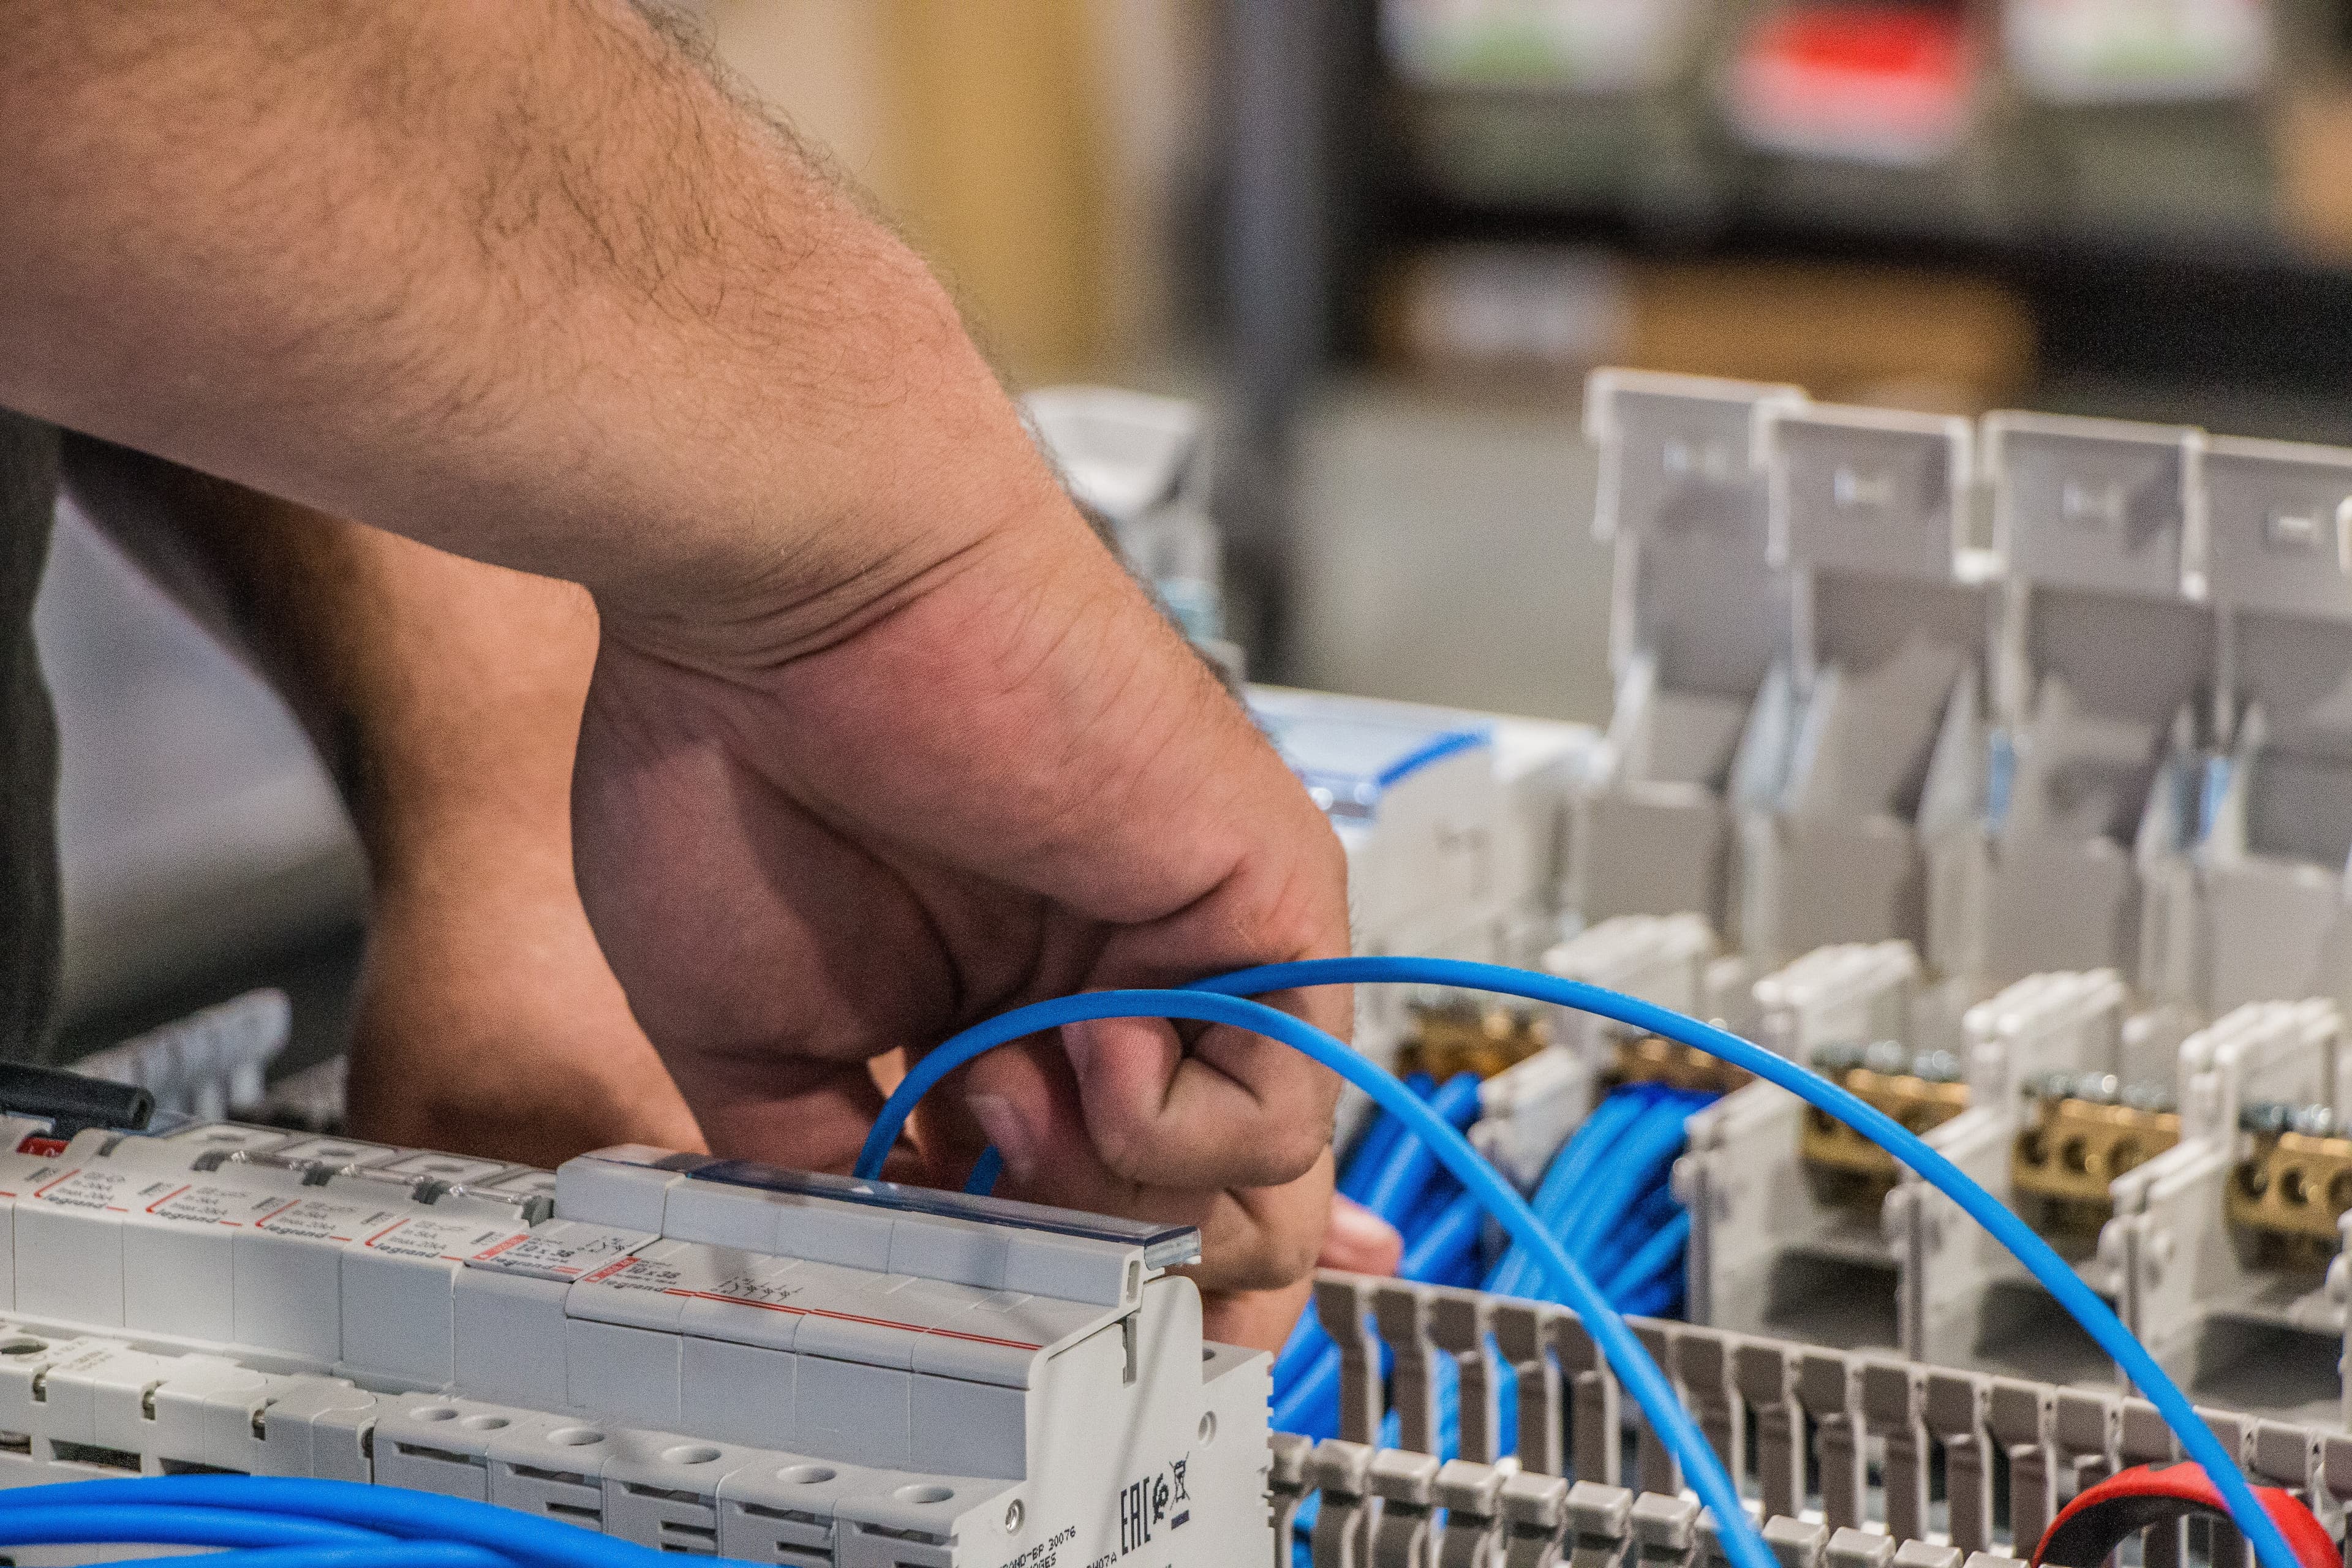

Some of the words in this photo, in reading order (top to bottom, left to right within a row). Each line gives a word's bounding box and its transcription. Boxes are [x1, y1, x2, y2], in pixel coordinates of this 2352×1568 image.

[43, 1194, 107, 1209] legrand
[156, 1208, 221, 1223] legrand
[264, 1224, 329, 1238] legrand
[375, 1243, 440, 1258] legrand
[491, 1256, 556, 1270] legrand
[600, 1278, 668, 1292] legrand
[1121, 1476, 1151, 1556] EAC
[1049, 1525, 1076, 1551] 30076
